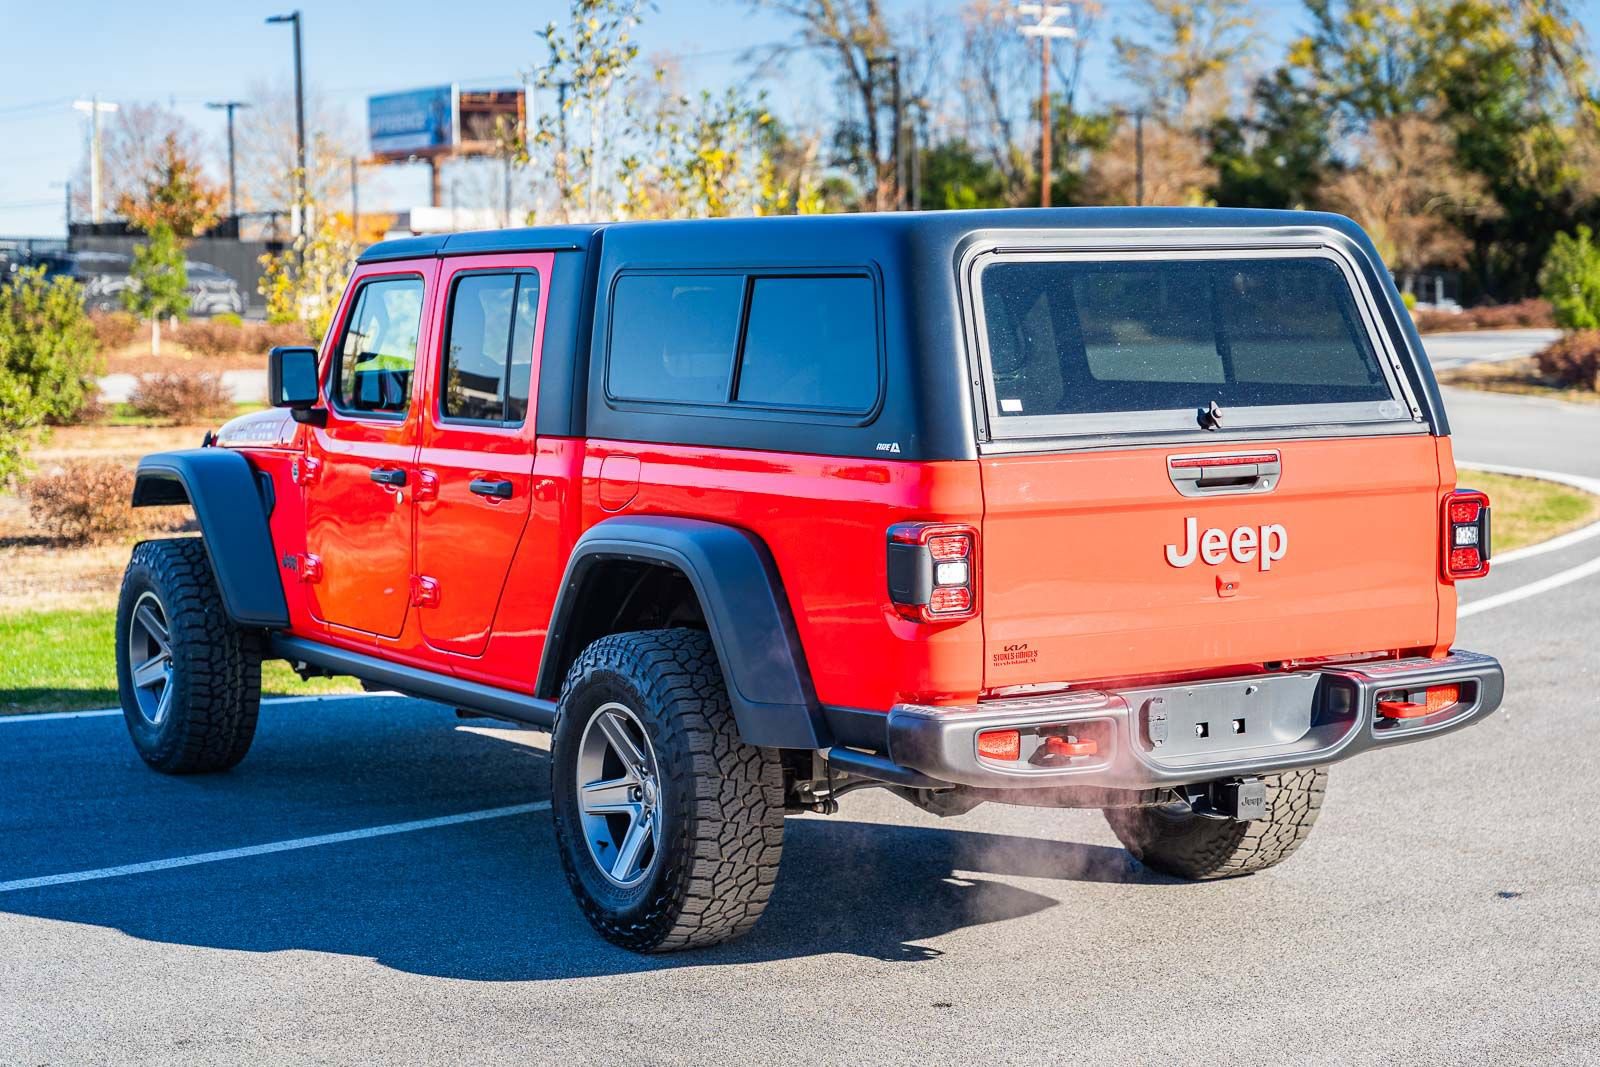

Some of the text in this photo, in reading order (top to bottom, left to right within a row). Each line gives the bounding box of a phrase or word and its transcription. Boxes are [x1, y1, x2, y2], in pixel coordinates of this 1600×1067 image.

[1164, 517, 1288, 572] Jeep
[1003, 643, 1028, 652] KIA
[1241, 796, 1263, 807] Jeep
